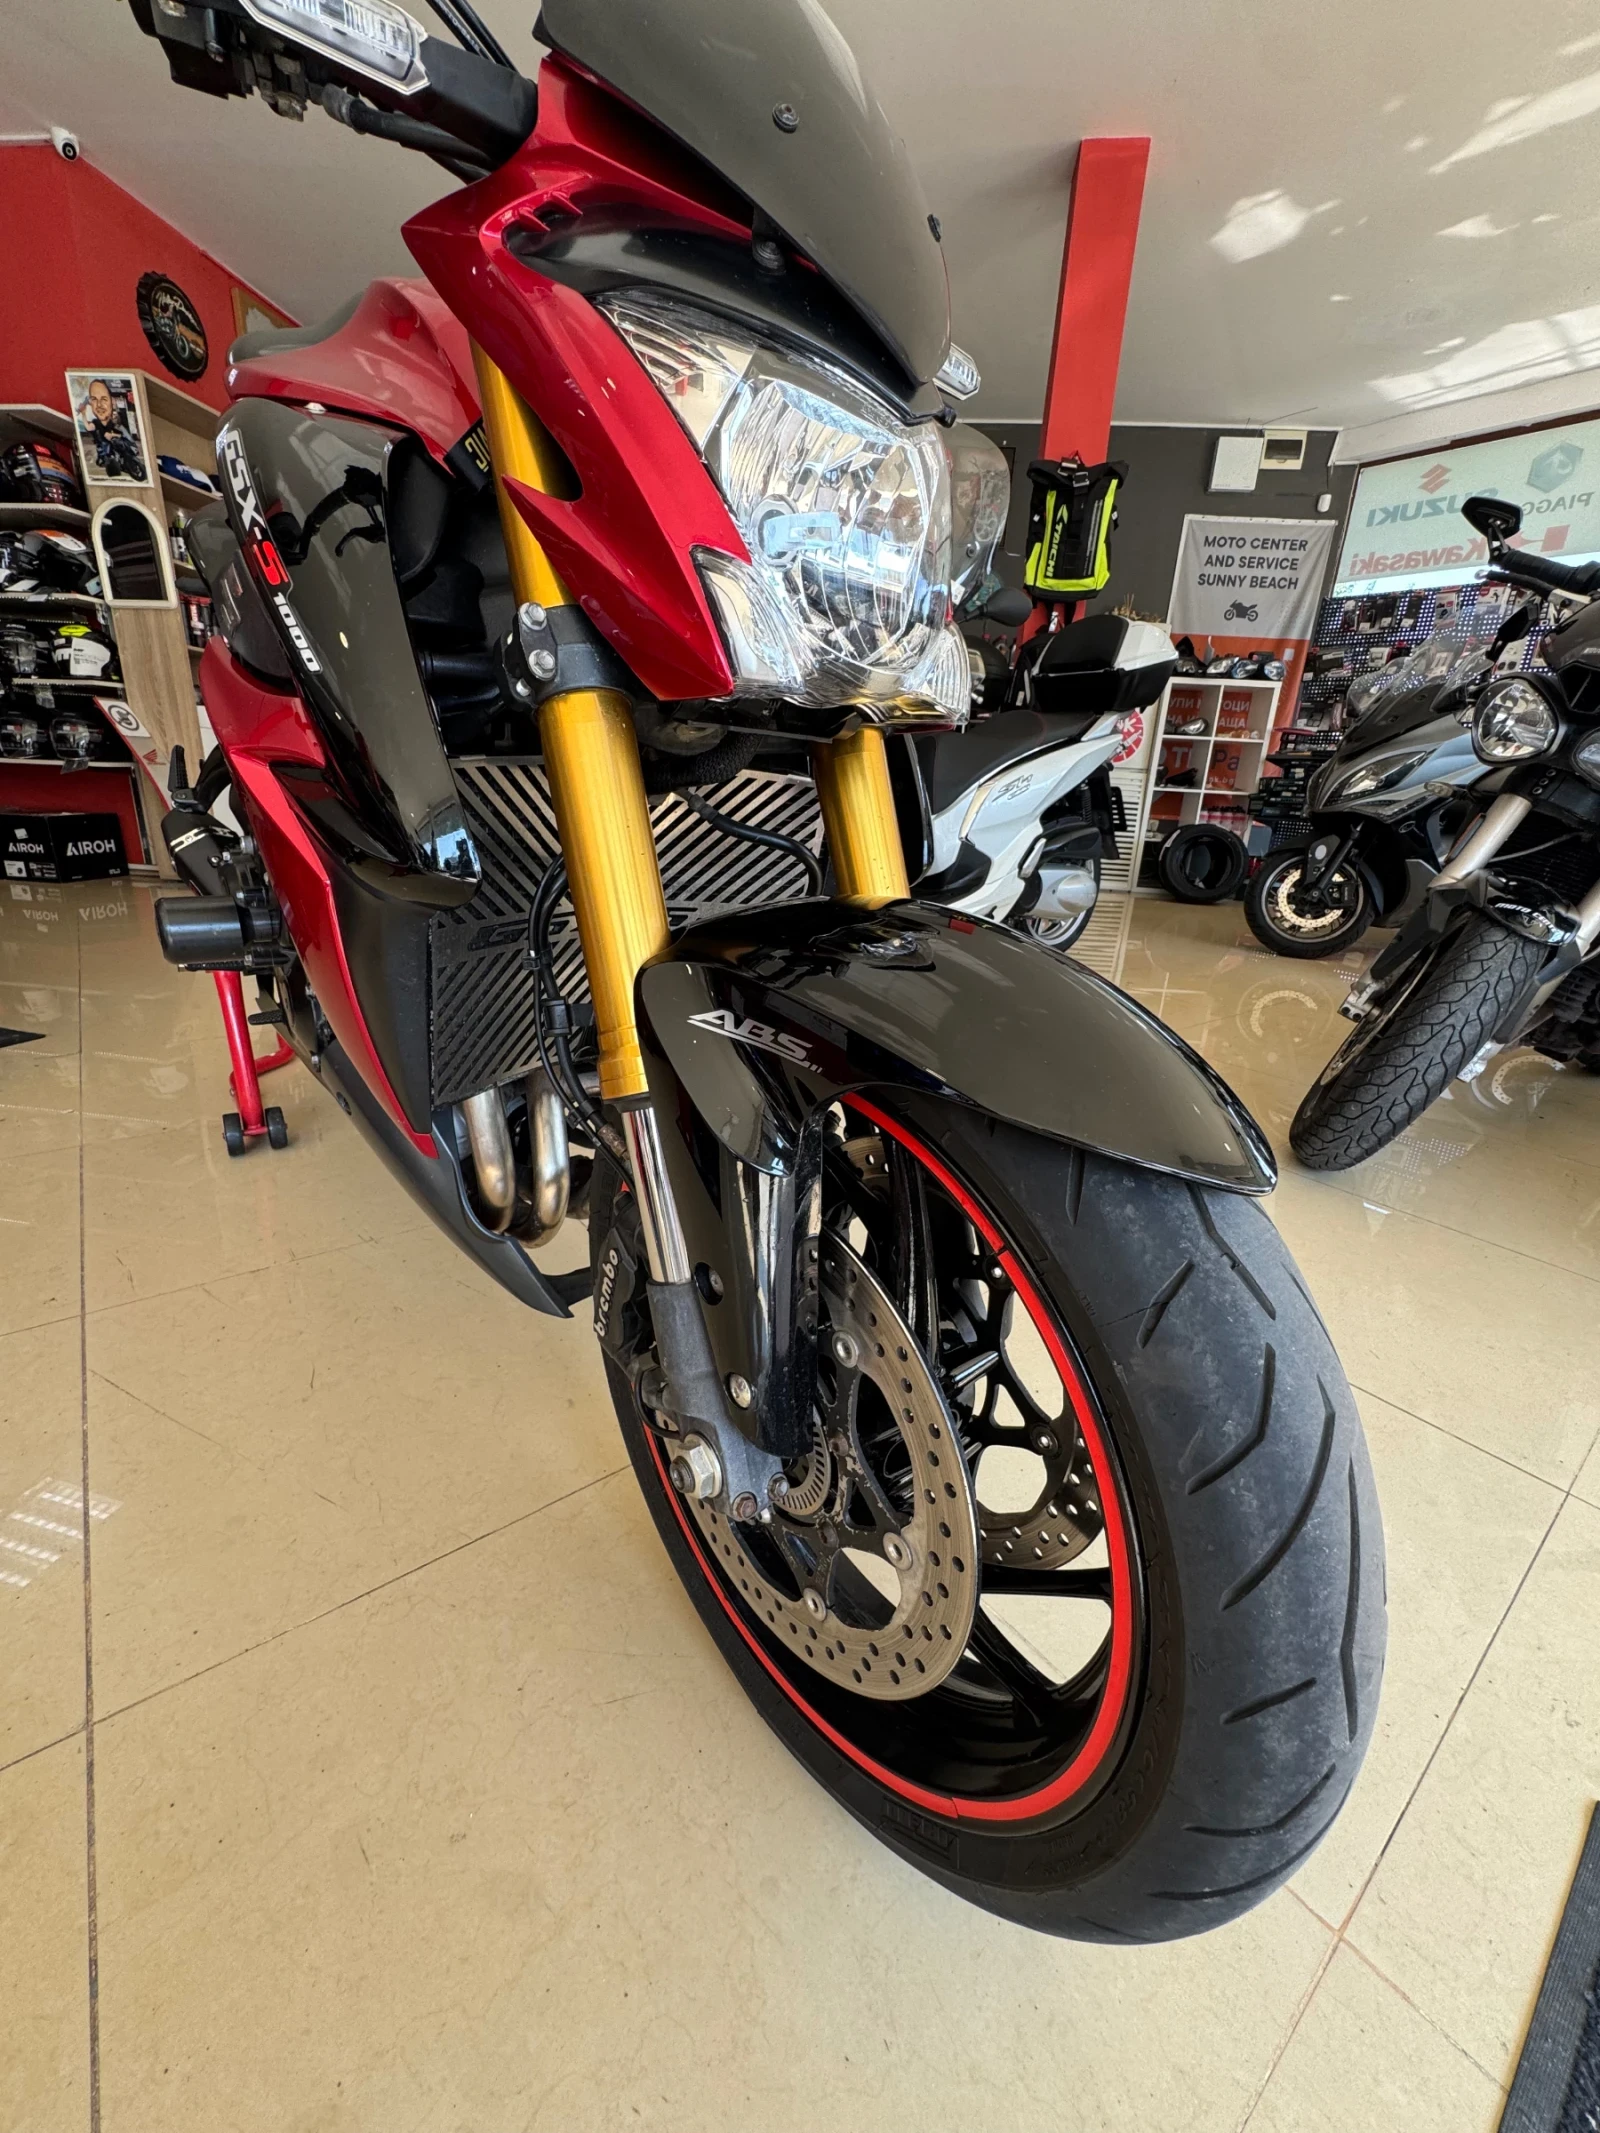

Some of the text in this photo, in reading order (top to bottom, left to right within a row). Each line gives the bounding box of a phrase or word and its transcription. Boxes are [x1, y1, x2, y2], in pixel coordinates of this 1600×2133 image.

[1045, 521, 1063, 578] TAICHI
[1203, 535, 1308, 551] MOTO CENTER
[1204, 554, 1300, 571] AND SERVICE
[1197, 573, 1299, 590] SUNNY BEACH
[272, 591, 322, 673] 1000
[1169, 697, 1194, 709] УПИ
[8, 841, 45, 854] AIROH
[66, 838, 117, 857] AIROH
[688, 1009, 814, 1061] ABS
[593, 1248, 619, 1338] brembo
